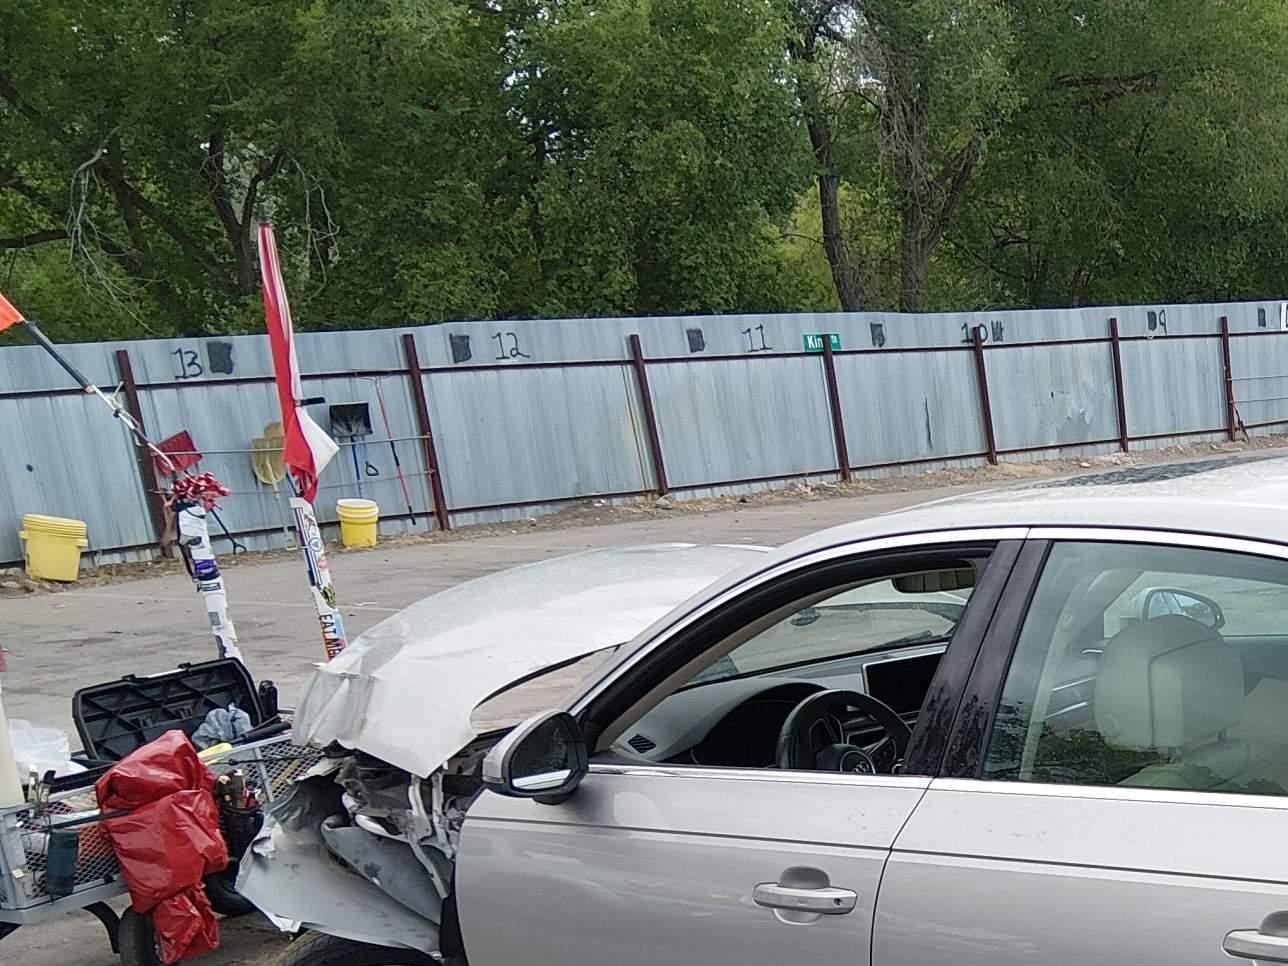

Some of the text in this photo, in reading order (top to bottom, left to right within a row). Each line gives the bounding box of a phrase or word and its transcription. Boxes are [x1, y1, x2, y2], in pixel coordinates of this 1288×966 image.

[741, 323, 773, 352] 11
[807, 335, 824, 349] Kin
[961, 322, 989, 344] 10
[491, 332, 531, 360] 12
[170, 347, 203, 379] 13
[318, 614, 337, 635] EAT
